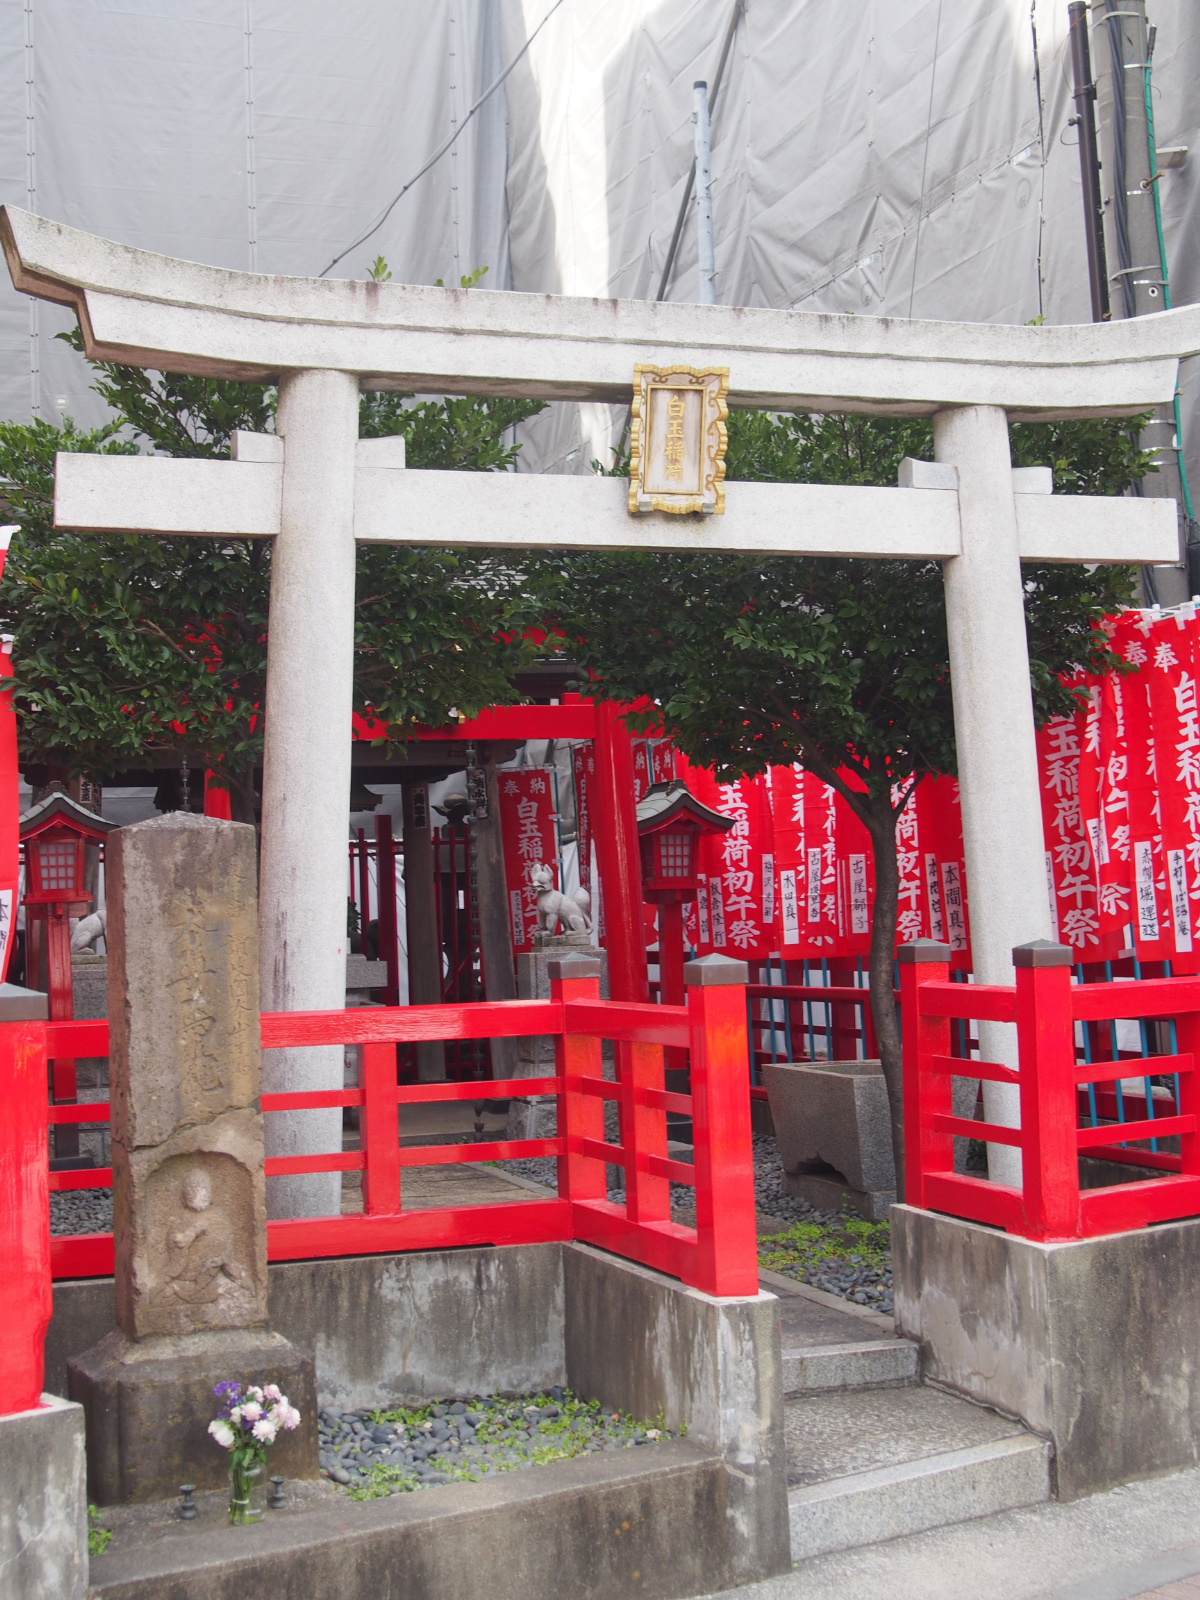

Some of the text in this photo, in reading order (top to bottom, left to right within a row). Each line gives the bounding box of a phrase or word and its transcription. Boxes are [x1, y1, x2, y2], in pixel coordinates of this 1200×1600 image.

[664, 395, 687, 484] 白玉稲荷
[503, 777, 546, 797] 奉納
[944, 865, 967, 948] 本間真子
